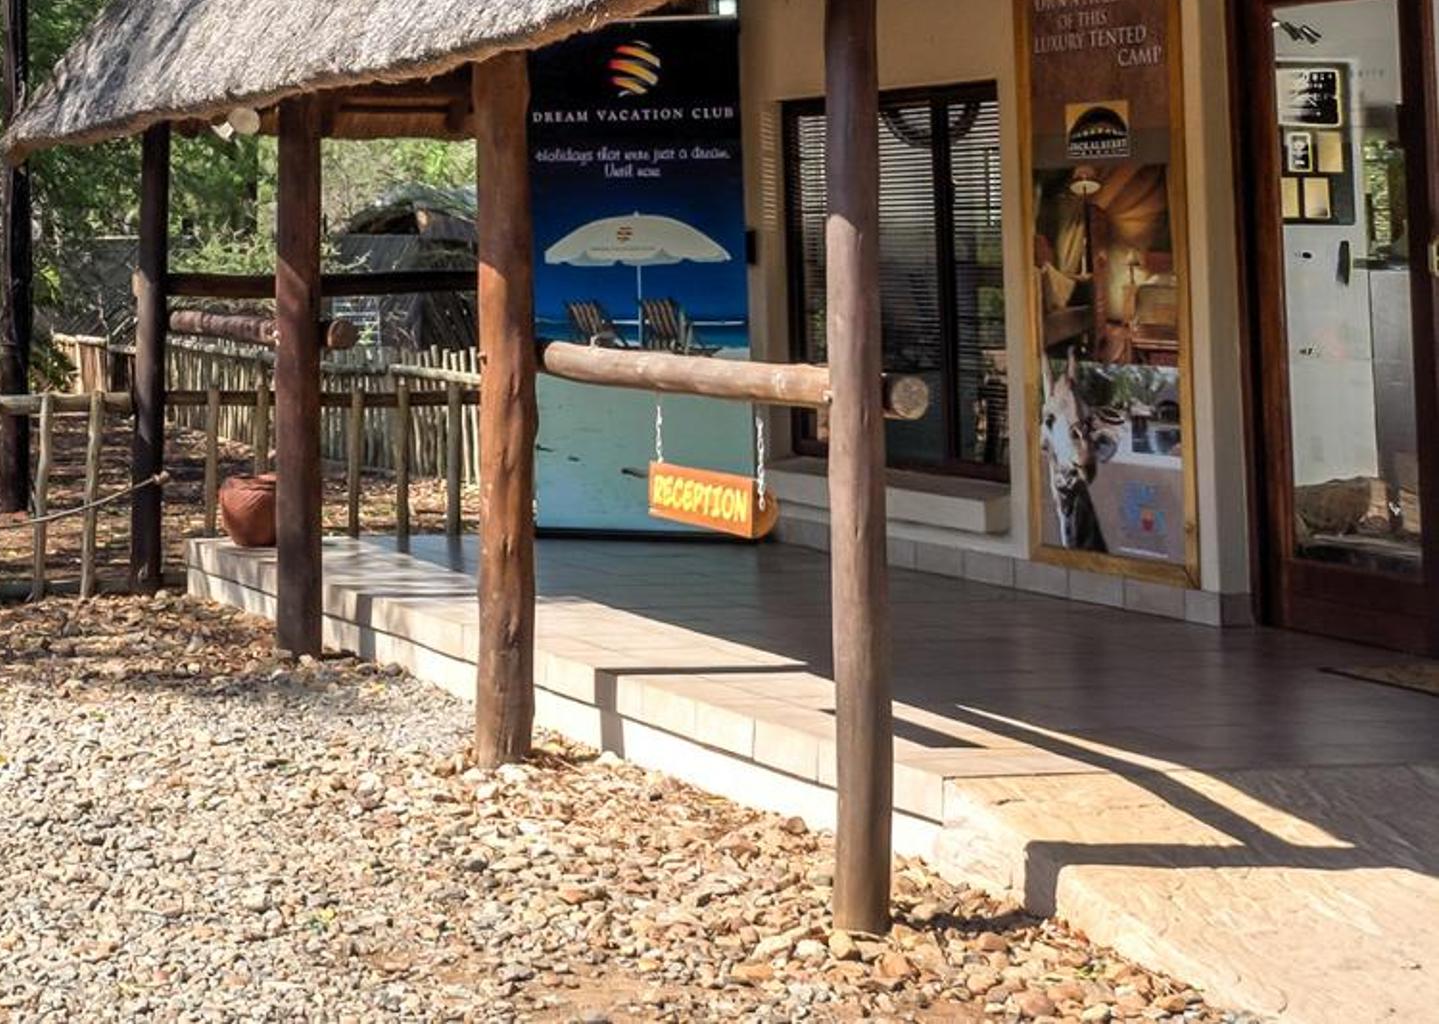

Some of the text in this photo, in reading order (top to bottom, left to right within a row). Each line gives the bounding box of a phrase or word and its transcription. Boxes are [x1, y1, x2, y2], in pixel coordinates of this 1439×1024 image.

[1058, 10, 1108, 29] OF THIS
[1034, 24, 1146, 53] LUXURY TENTED
[1118, 45, 1162, 67] CAMP
[532, 106, 735, 123] DREAM VACATION CLUB
[678, 149, 688, 160] a
[653, 475, 748, 522] RECEPTION
